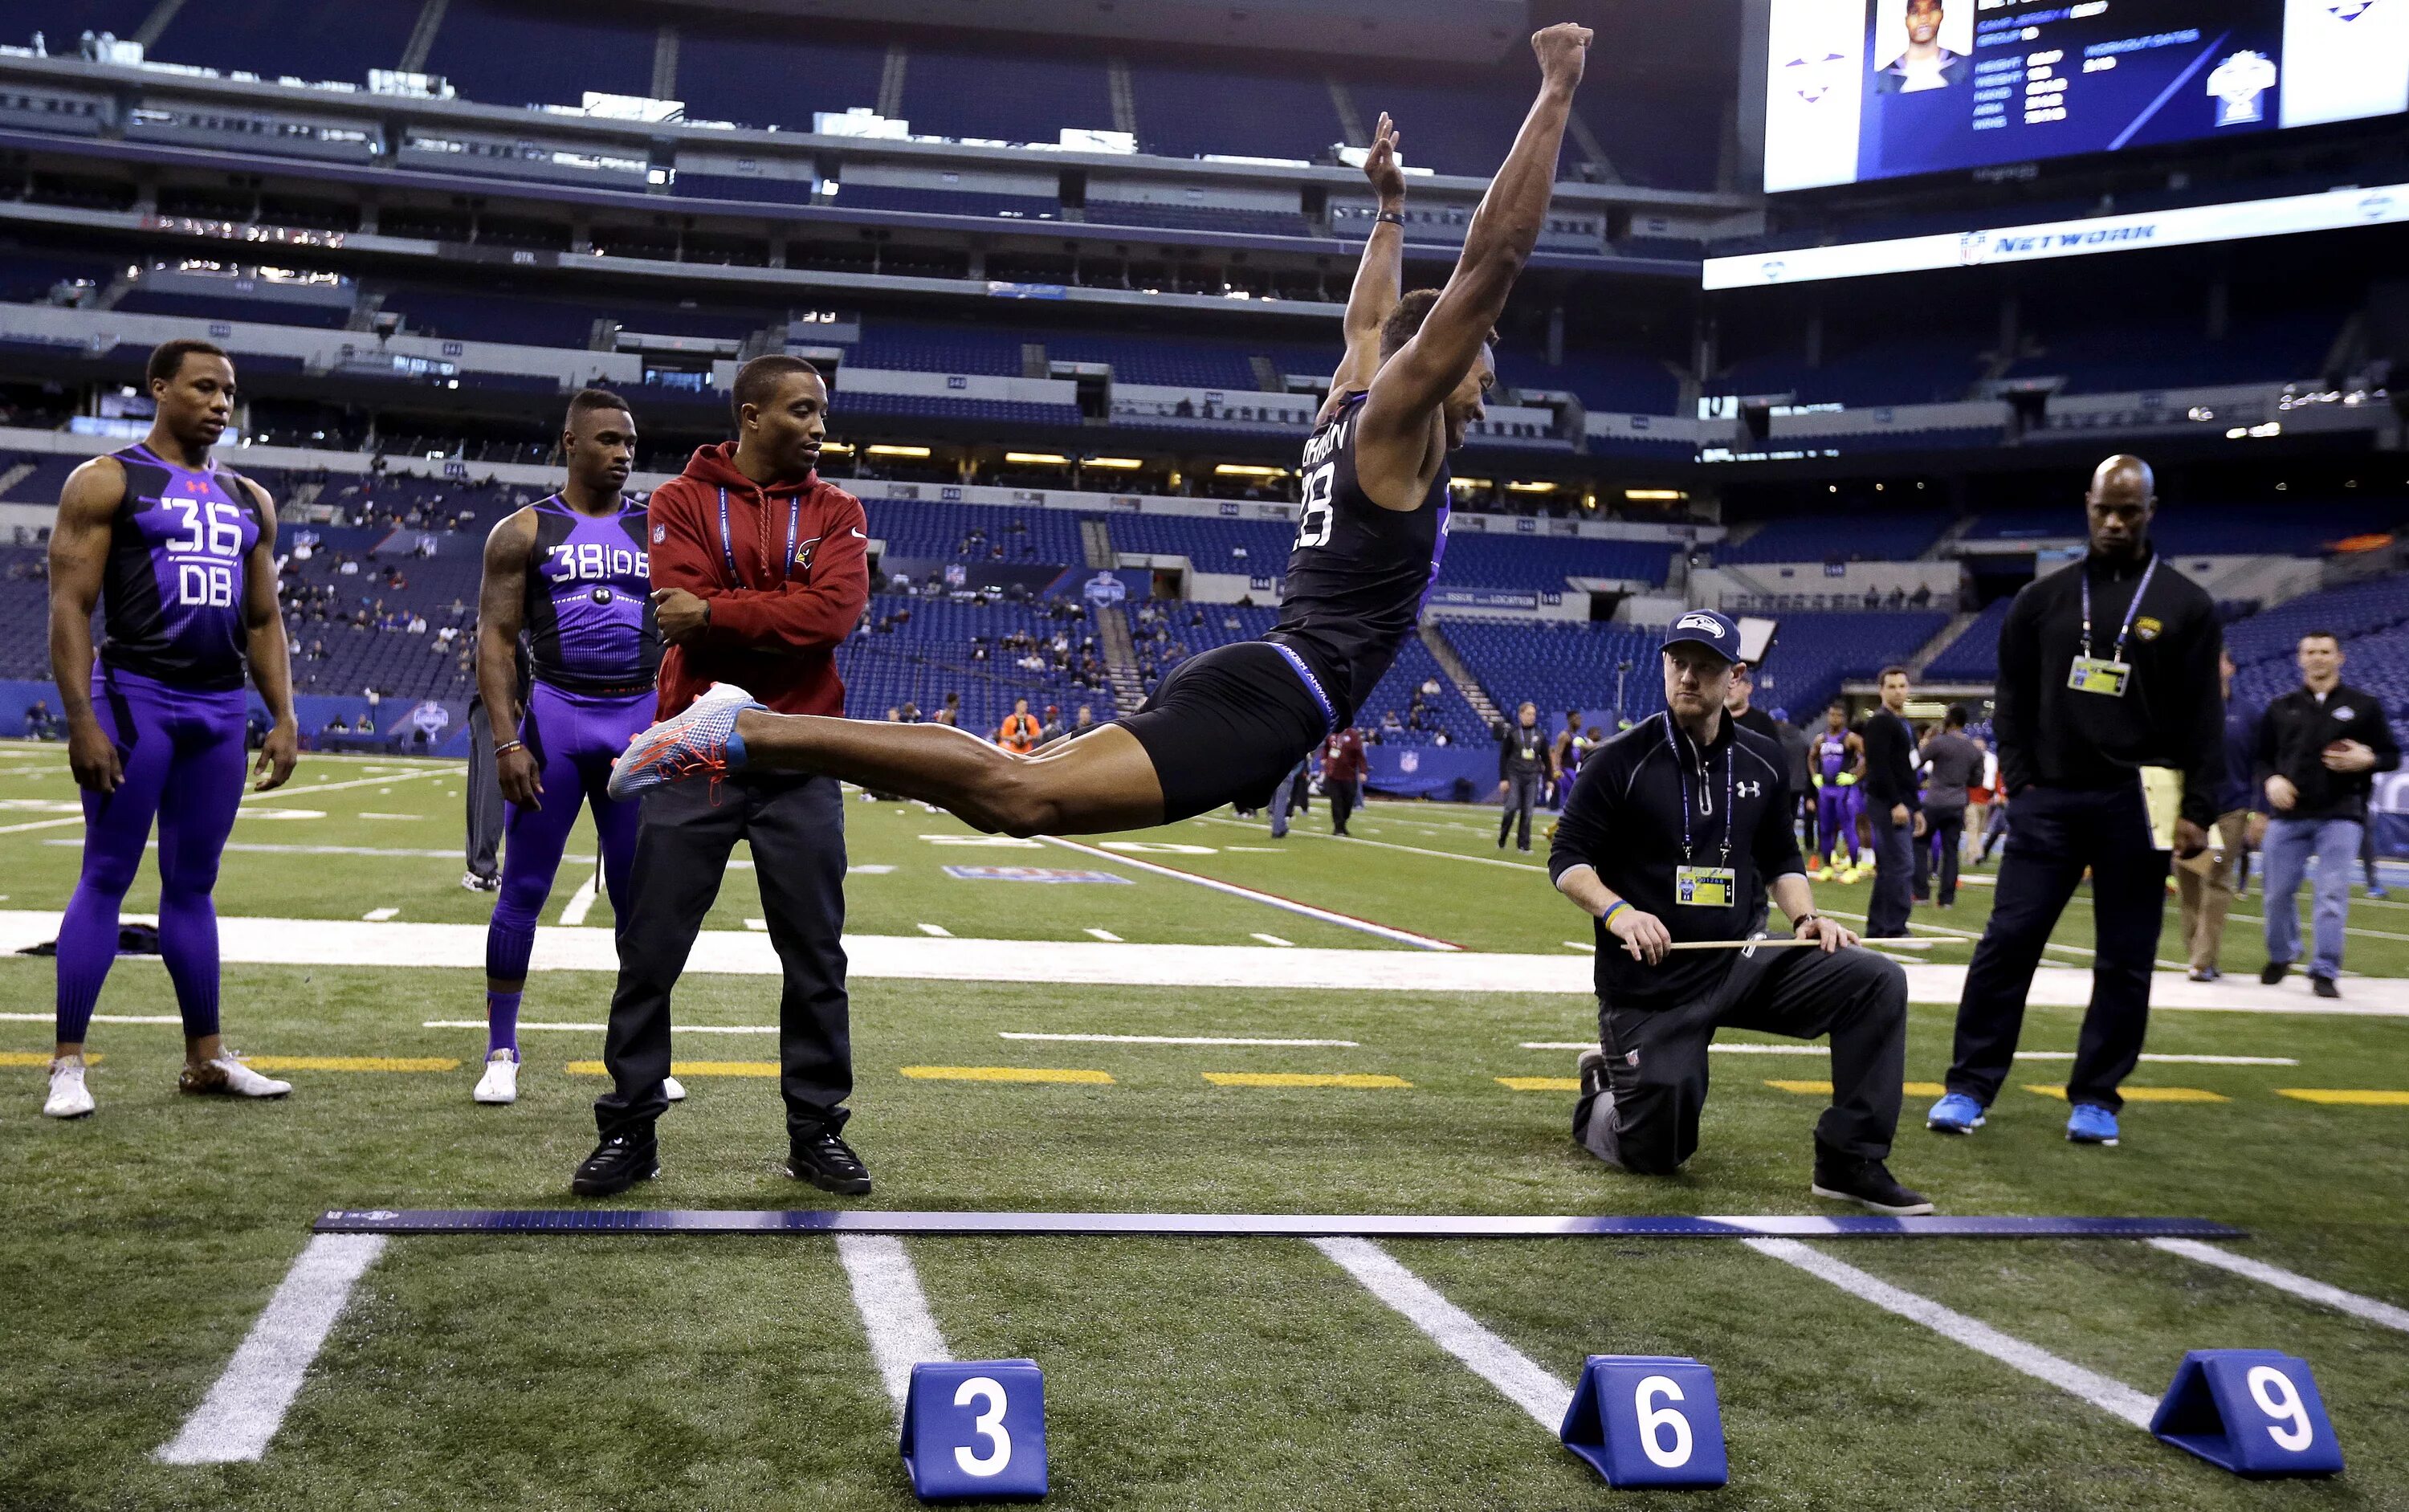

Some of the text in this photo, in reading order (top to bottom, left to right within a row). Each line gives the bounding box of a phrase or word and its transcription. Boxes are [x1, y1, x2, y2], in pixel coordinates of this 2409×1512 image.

[1995, 225, 2158, 255] NETWORK
[161, 497, 243, 557] 36
[179, 564, 232, 608] DB
[1490, 594, 1536, 606] LOCATION
[953, 1376, 1013, 1477] 3
[1634, 1375, 1694, 1468] 6
[2248, 1365, 2313, 1452] 9
